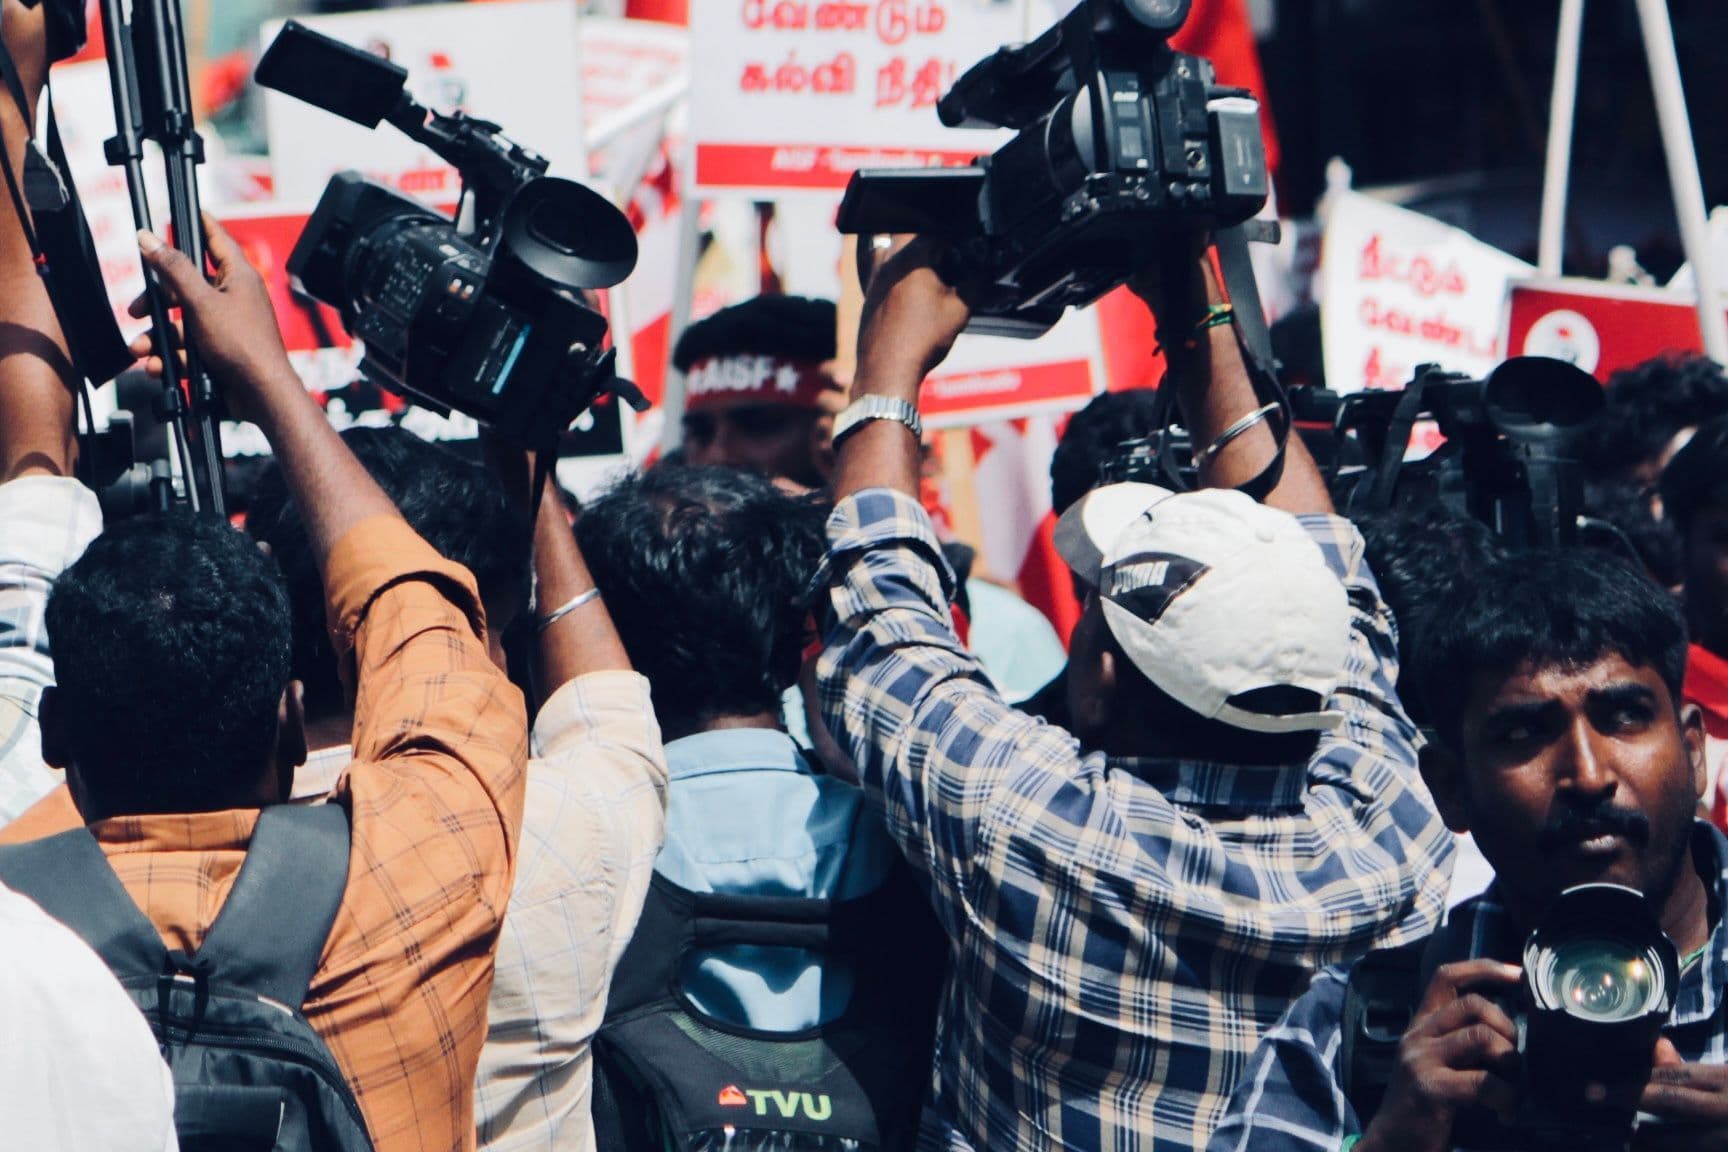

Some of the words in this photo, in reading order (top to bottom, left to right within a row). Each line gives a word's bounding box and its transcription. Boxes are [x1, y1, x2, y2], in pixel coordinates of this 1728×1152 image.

[740, 52, 855, 94] கல்வி
[704, 354, 775, 394] AISF
[745, 1089, 832, 1121] TVU
